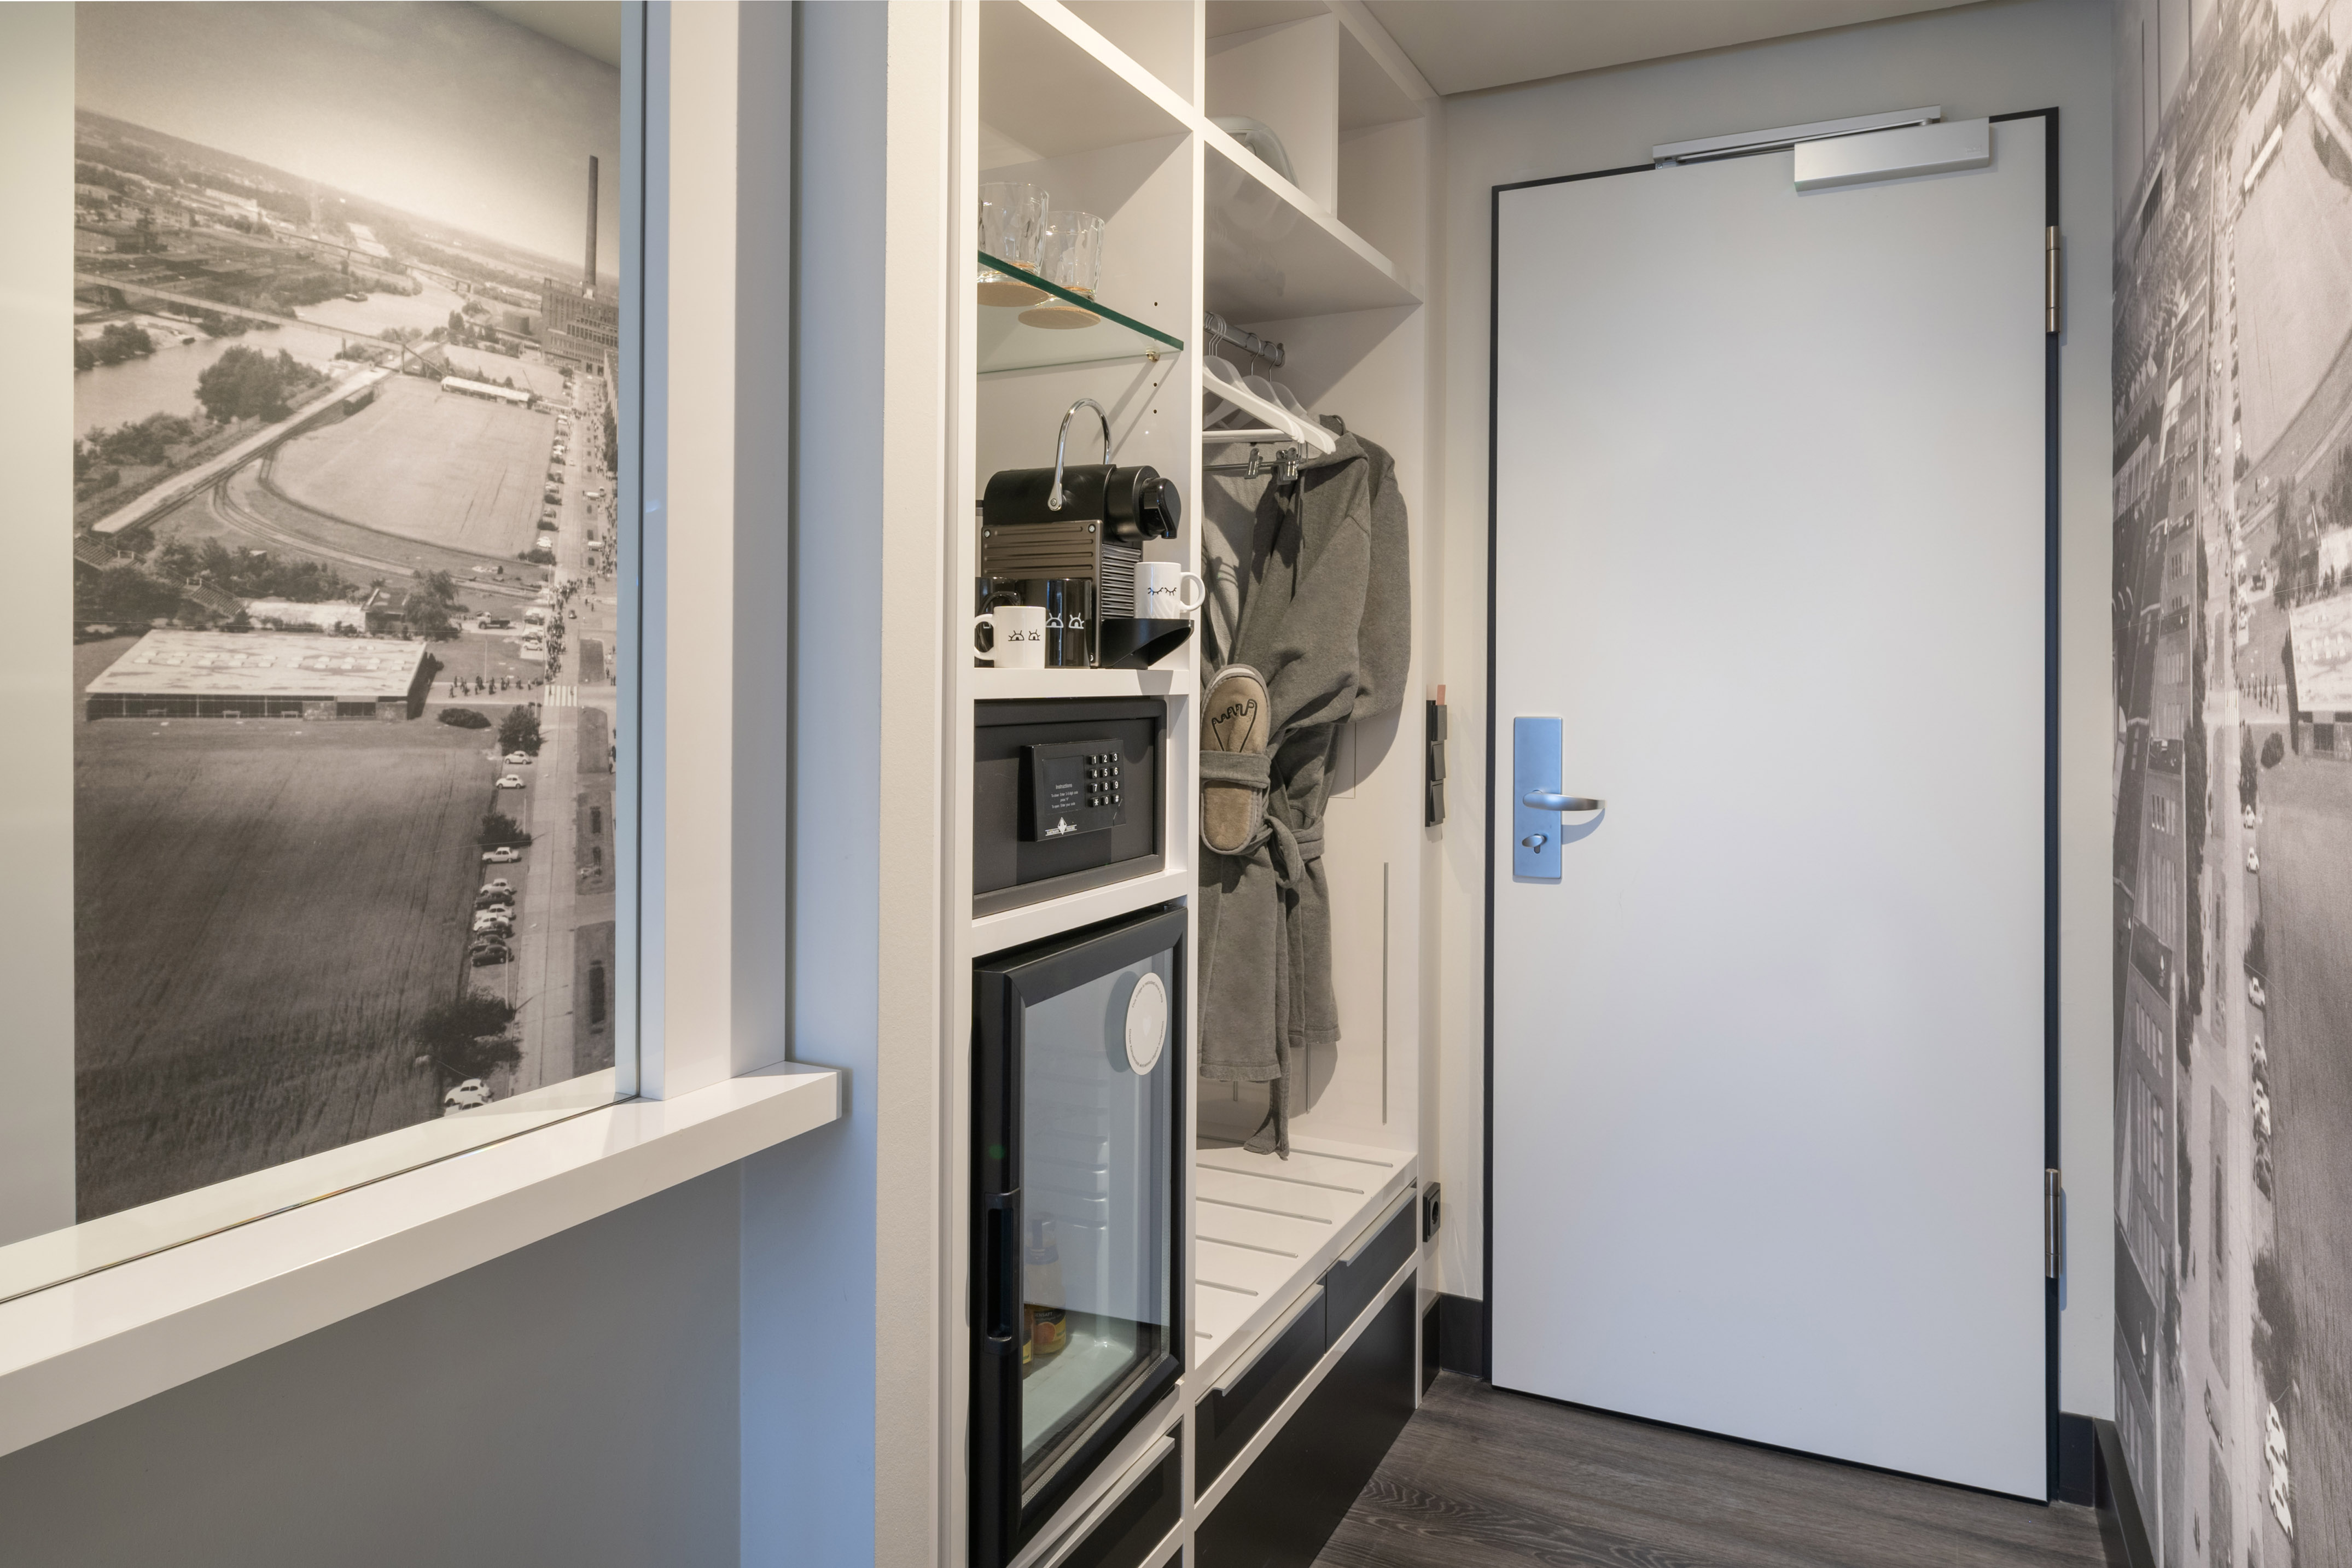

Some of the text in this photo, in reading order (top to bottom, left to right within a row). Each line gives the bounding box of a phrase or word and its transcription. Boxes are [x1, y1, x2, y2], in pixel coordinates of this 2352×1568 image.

[1093, 755, 1096, 763] 1
[1114, 753, 1117, 761] 3
[1094, 770, 1097, 778] 4
[1114, 767, 1118, 775] 6
[1095, 784, 1098, 792] 7
[1105, 782, 1108, 790] 8
[1105, 796, 1109, 805] 0
